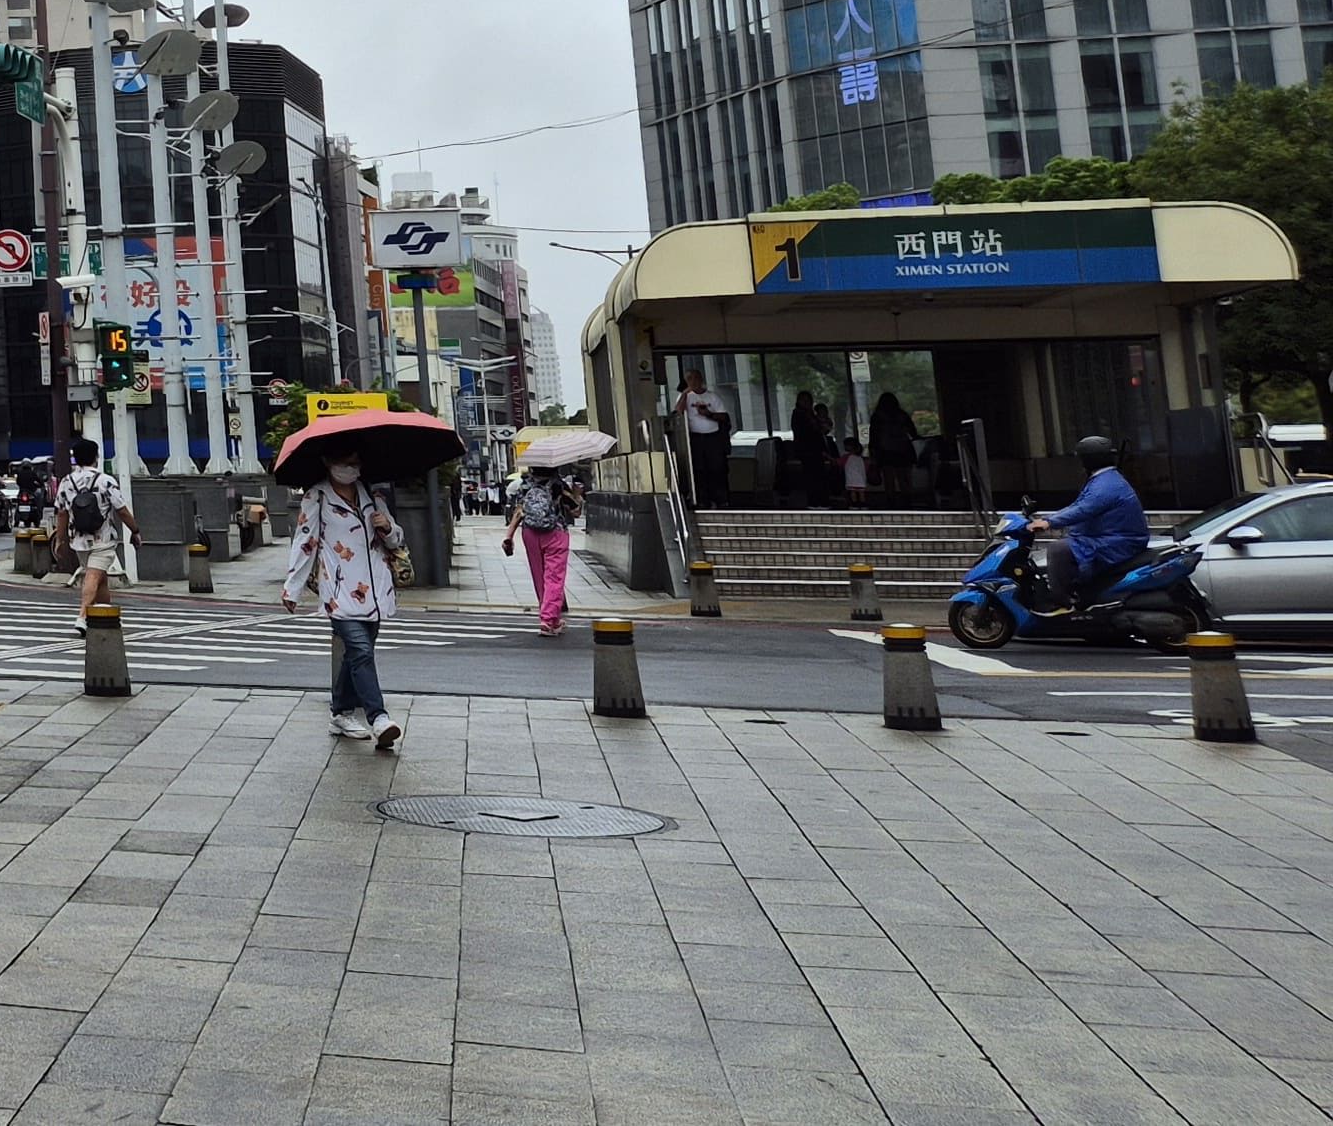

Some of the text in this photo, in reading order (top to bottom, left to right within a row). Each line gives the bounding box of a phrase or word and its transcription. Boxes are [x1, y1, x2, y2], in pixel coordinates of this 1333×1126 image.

[893, 228, 1004, 260] 西門站
[775, 237, 802, 282] 1
[895, 262, 1010, 277] XIMEN STATION
[110, 329, 127, 353] 15
